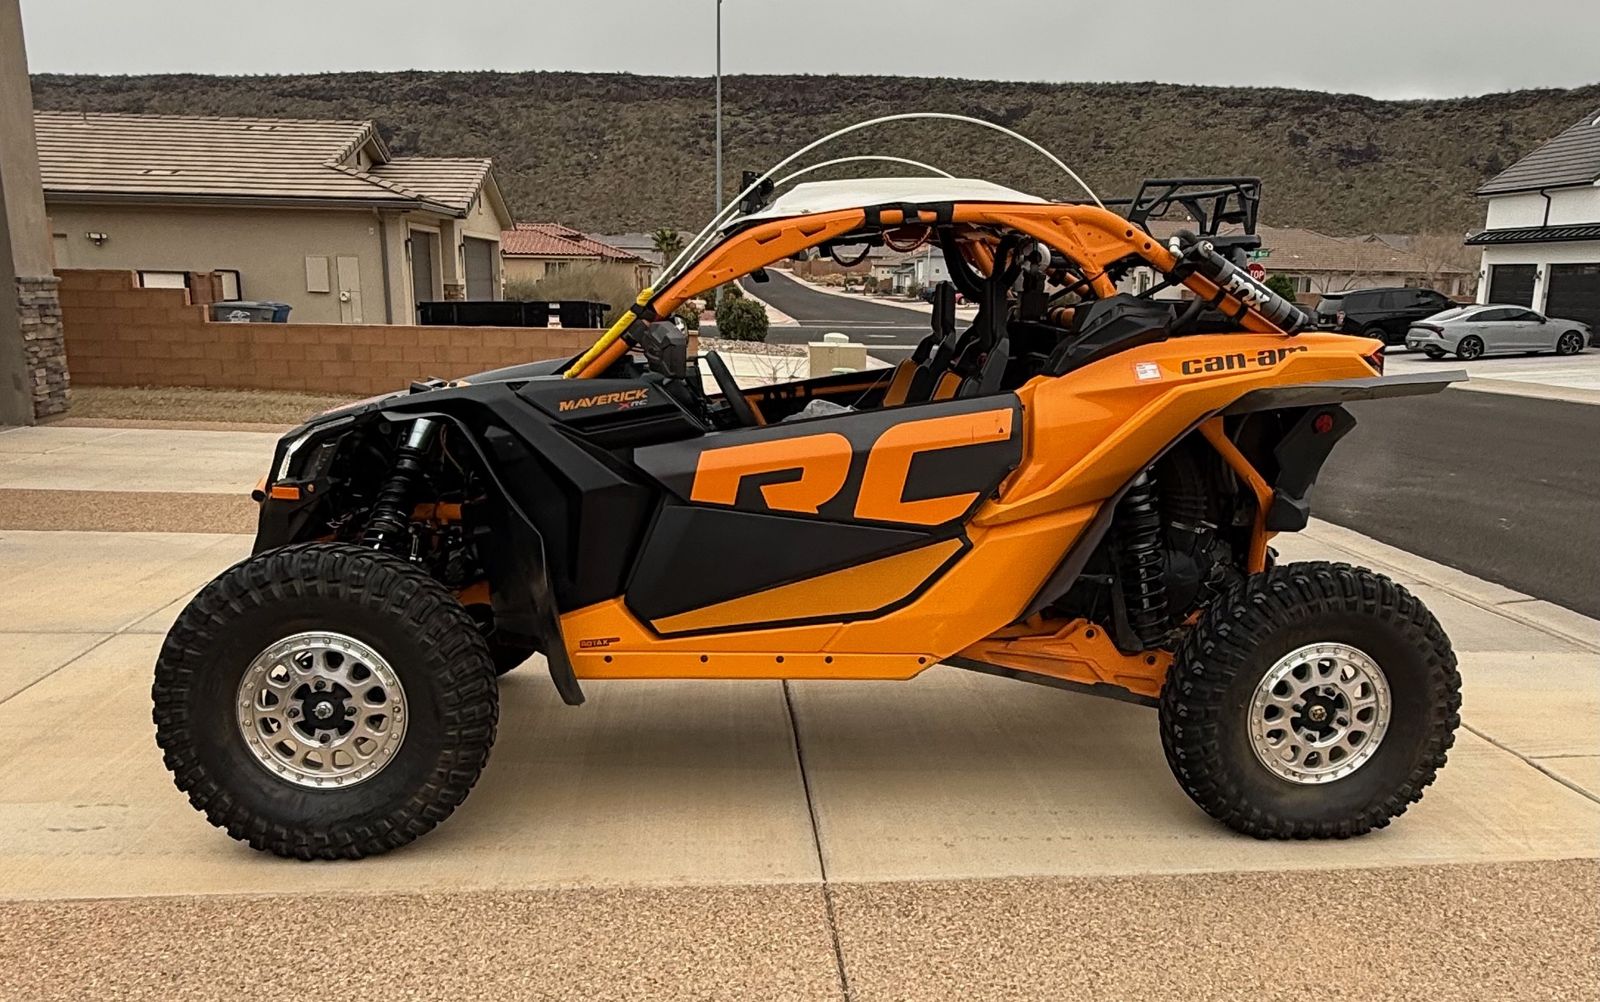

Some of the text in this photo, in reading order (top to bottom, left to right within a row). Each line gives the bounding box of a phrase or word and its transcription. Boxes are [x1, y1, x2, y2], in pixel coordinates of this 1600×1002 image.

[1249, 270, 1265, 280] TOP
[1223, 273, 1270, 311] FOX
[559, 388, 648, 411] MAVERICK
[690, 408, 1013, 525] RC
